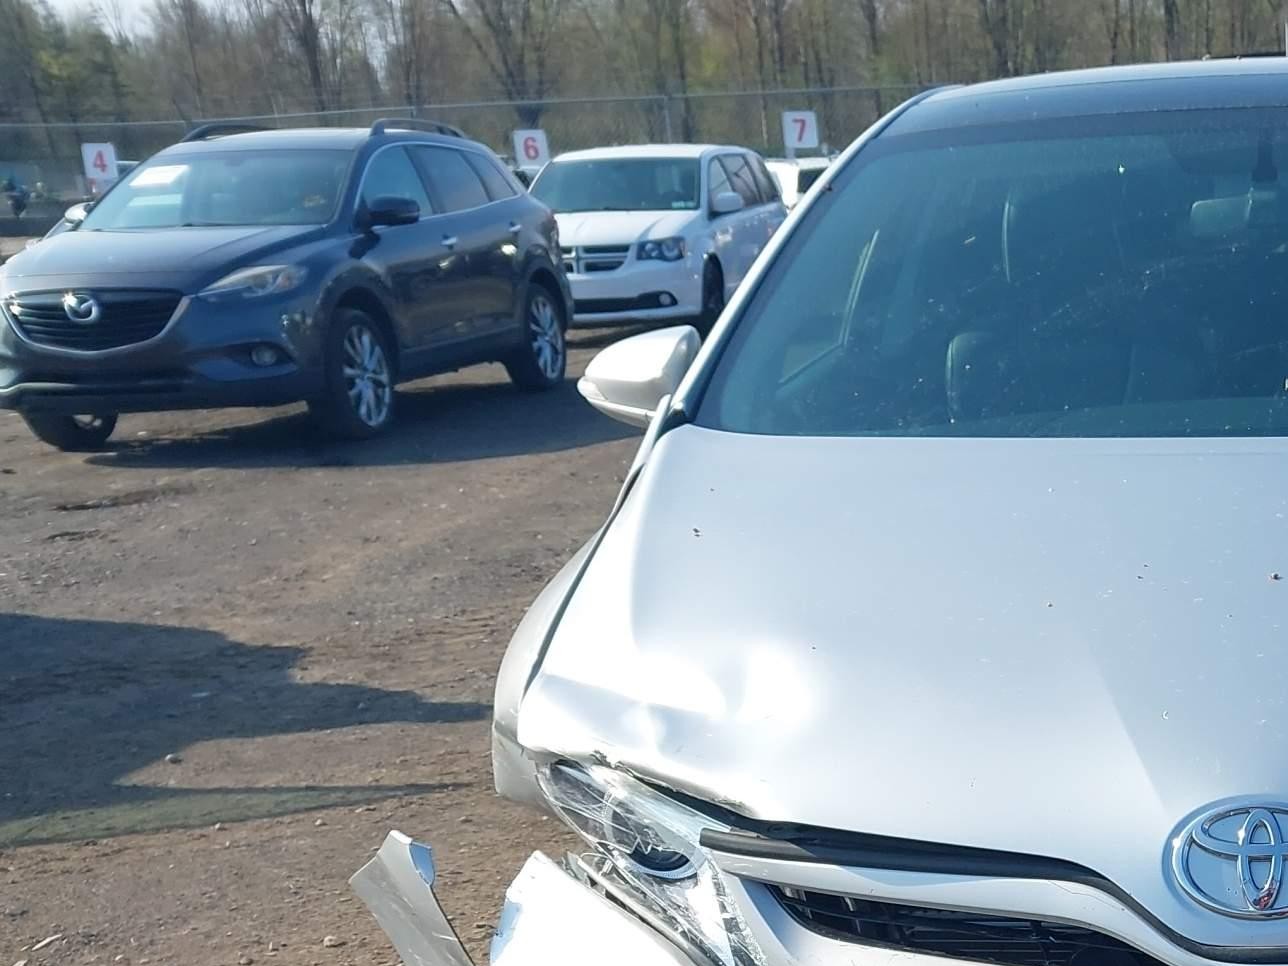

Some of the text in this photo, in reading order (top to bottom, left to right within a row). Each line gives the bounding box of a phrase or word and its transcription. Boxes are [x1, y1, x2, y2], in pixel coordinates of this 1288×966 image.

[792, 117, 808, 143] 7
[523, 136, 540, 160] 6
[92, 149, 108, 173] 4
